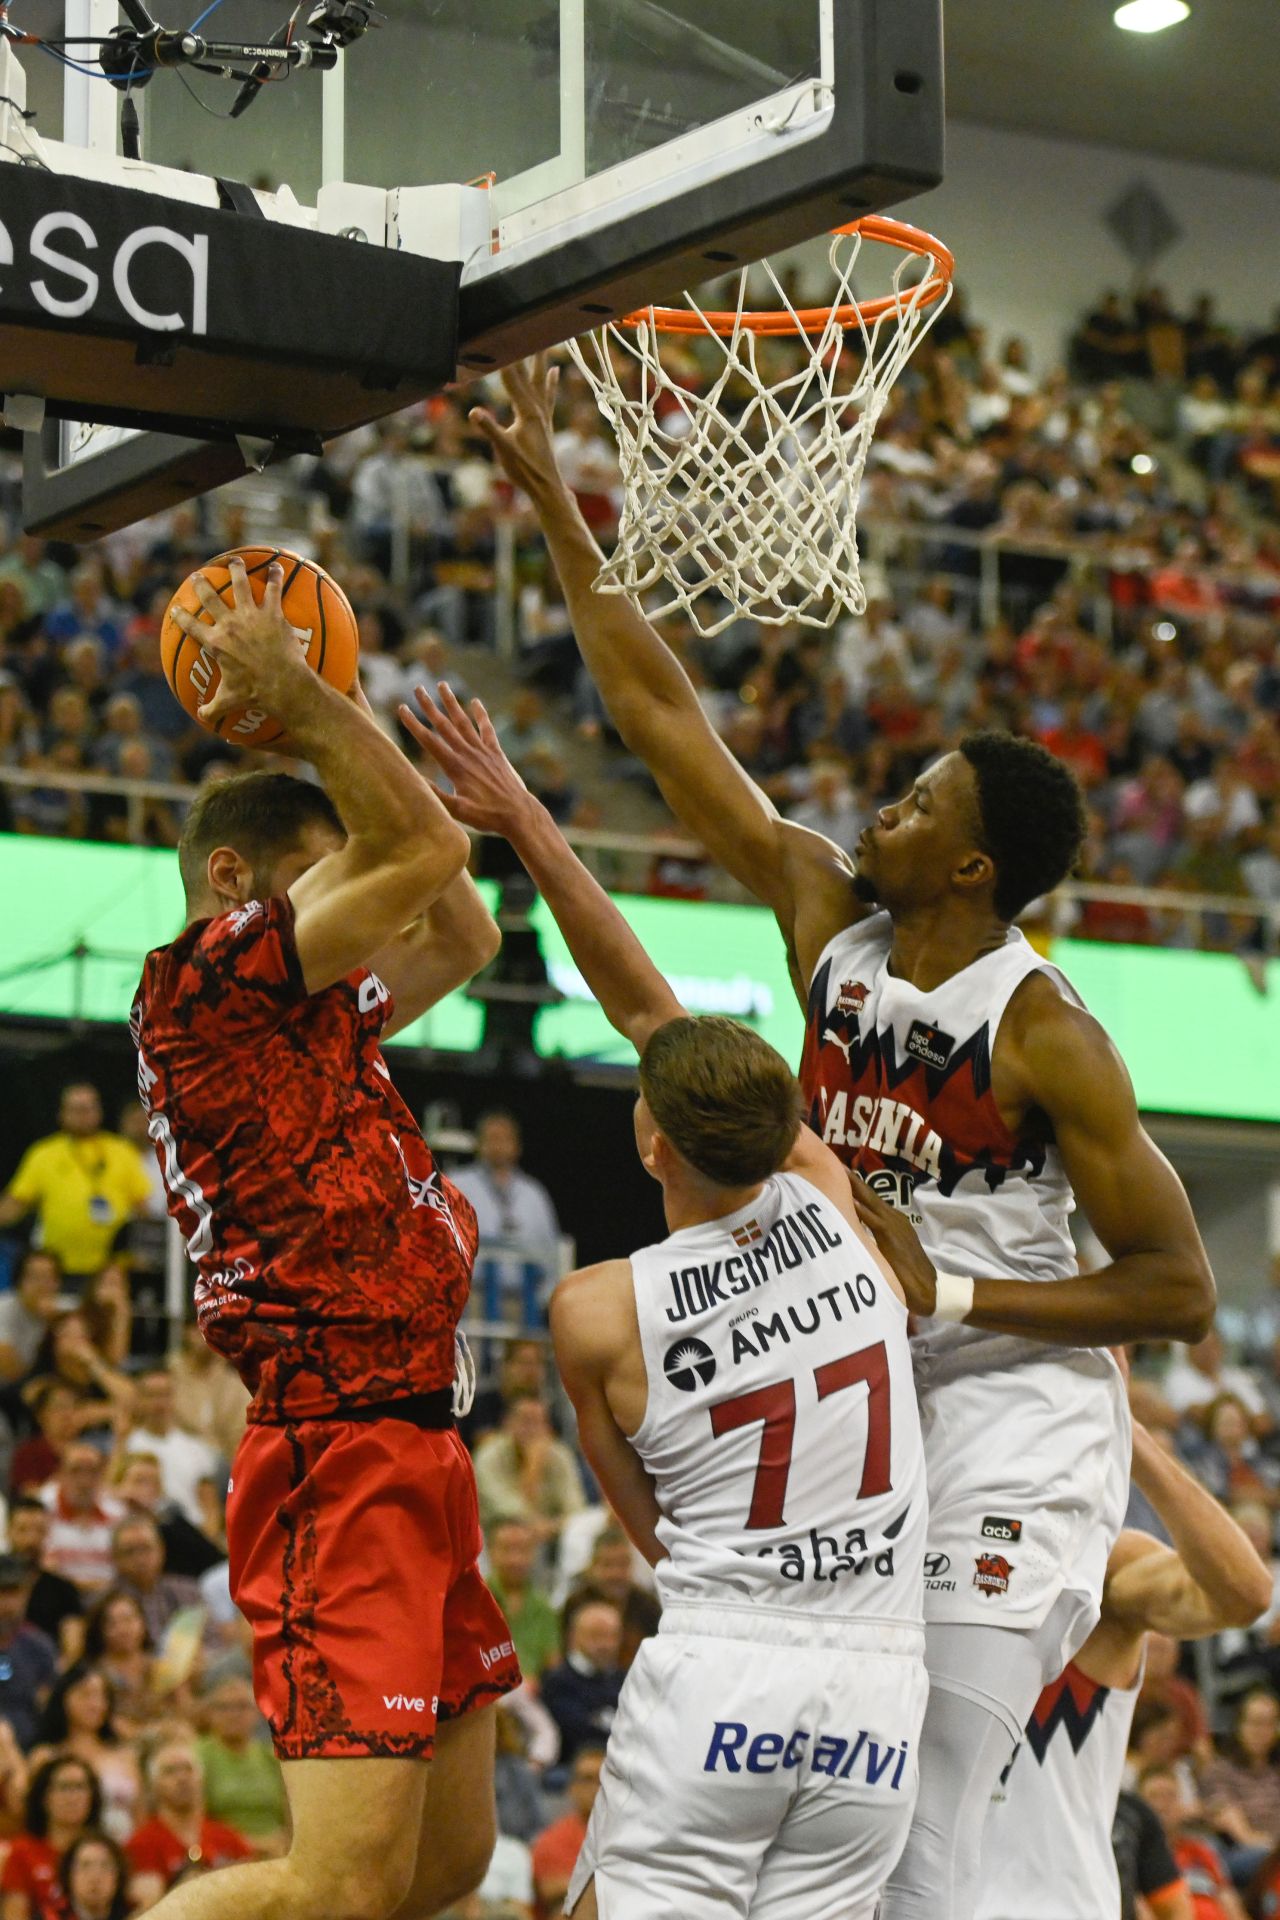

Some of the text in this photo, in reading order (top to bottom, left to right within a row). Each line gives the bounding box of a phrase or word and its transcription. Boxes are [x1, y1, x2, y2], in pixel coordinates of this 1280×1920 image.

[0, 211, 208, 335] sa
[908, 1041, 946, 1065] endesa
[912, 1031, 930, 1046] liga
[665, 1203, 842, 1322] JOKSIMOVIC
[728, 1307, 759, 1328] GRUPO
[732, 1273, 876, 1366] AMUTIO
[709, 1340, 893, 1530] 77
[984, 1526, 1012, 1539] acb
[383, 1693, 425, 1712] vive
[704, 1721, 908, 1790] Recalvi
